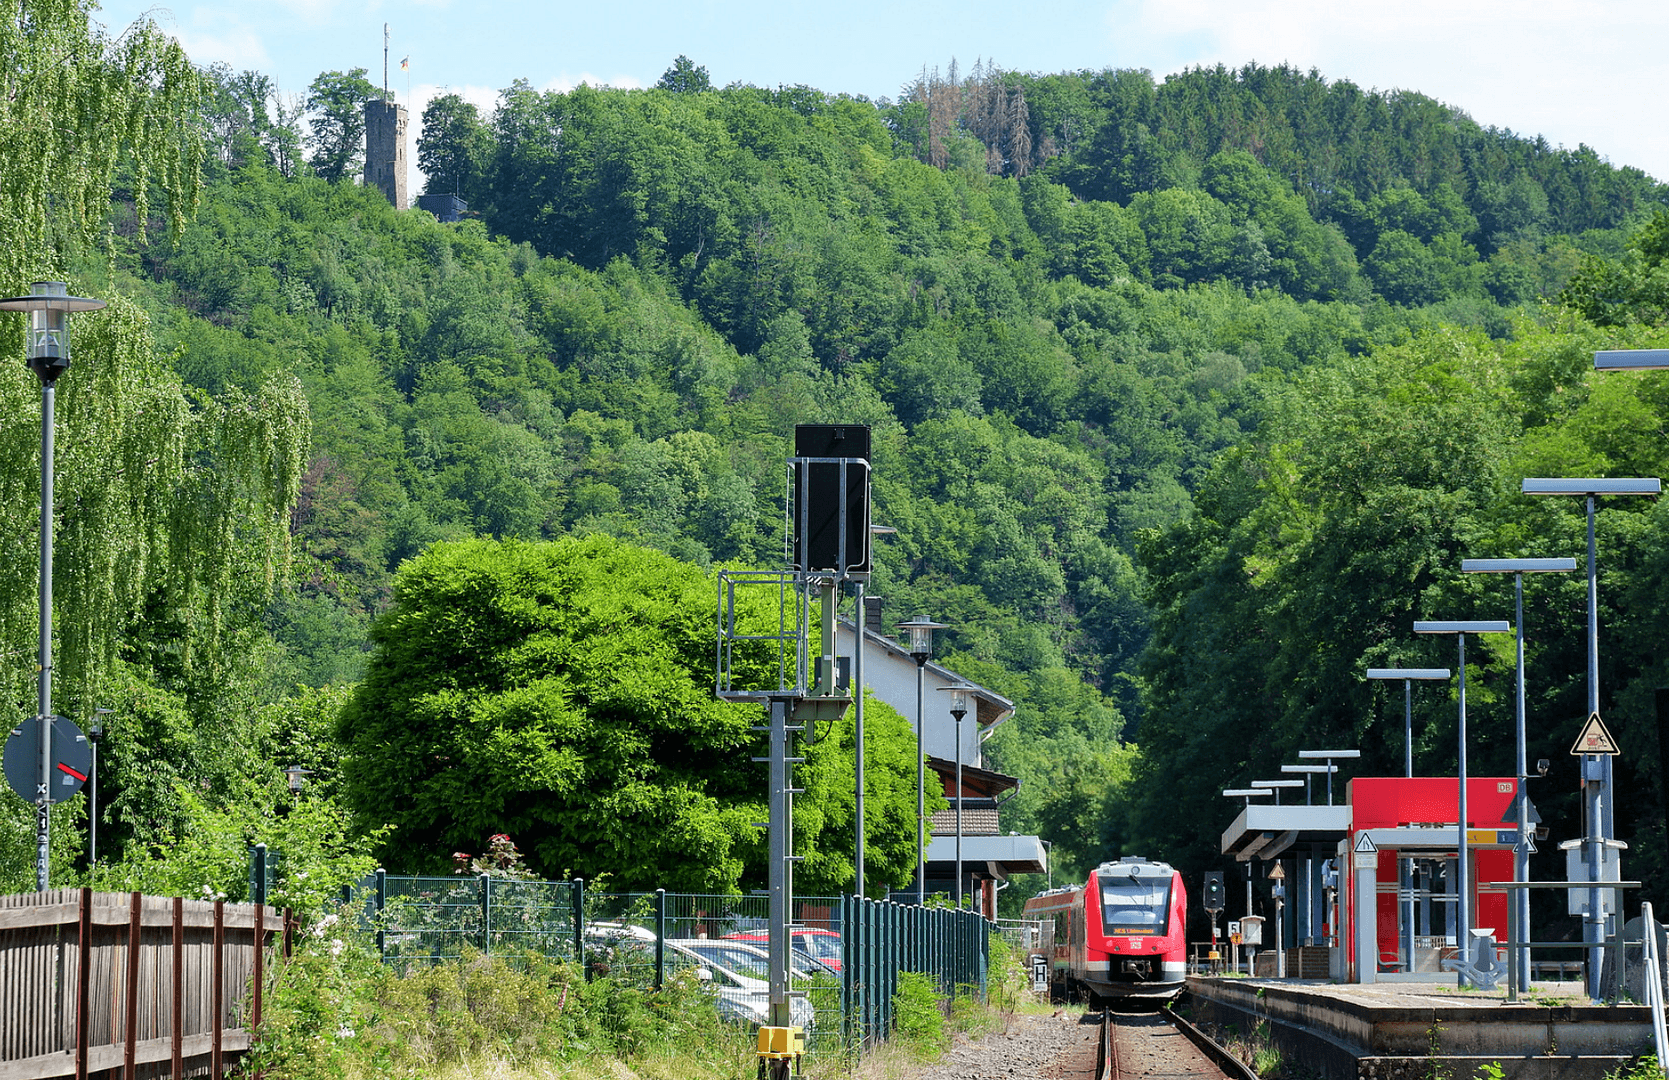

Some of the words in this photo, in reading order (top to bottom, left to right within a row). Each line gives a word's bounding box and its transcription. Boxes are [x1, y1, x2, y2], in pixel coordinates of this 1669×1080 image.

[1498, 783, 1512, 792] DB
[1231, 924, 1237, 934] 5
[1036, 966, 1046, 982] H
